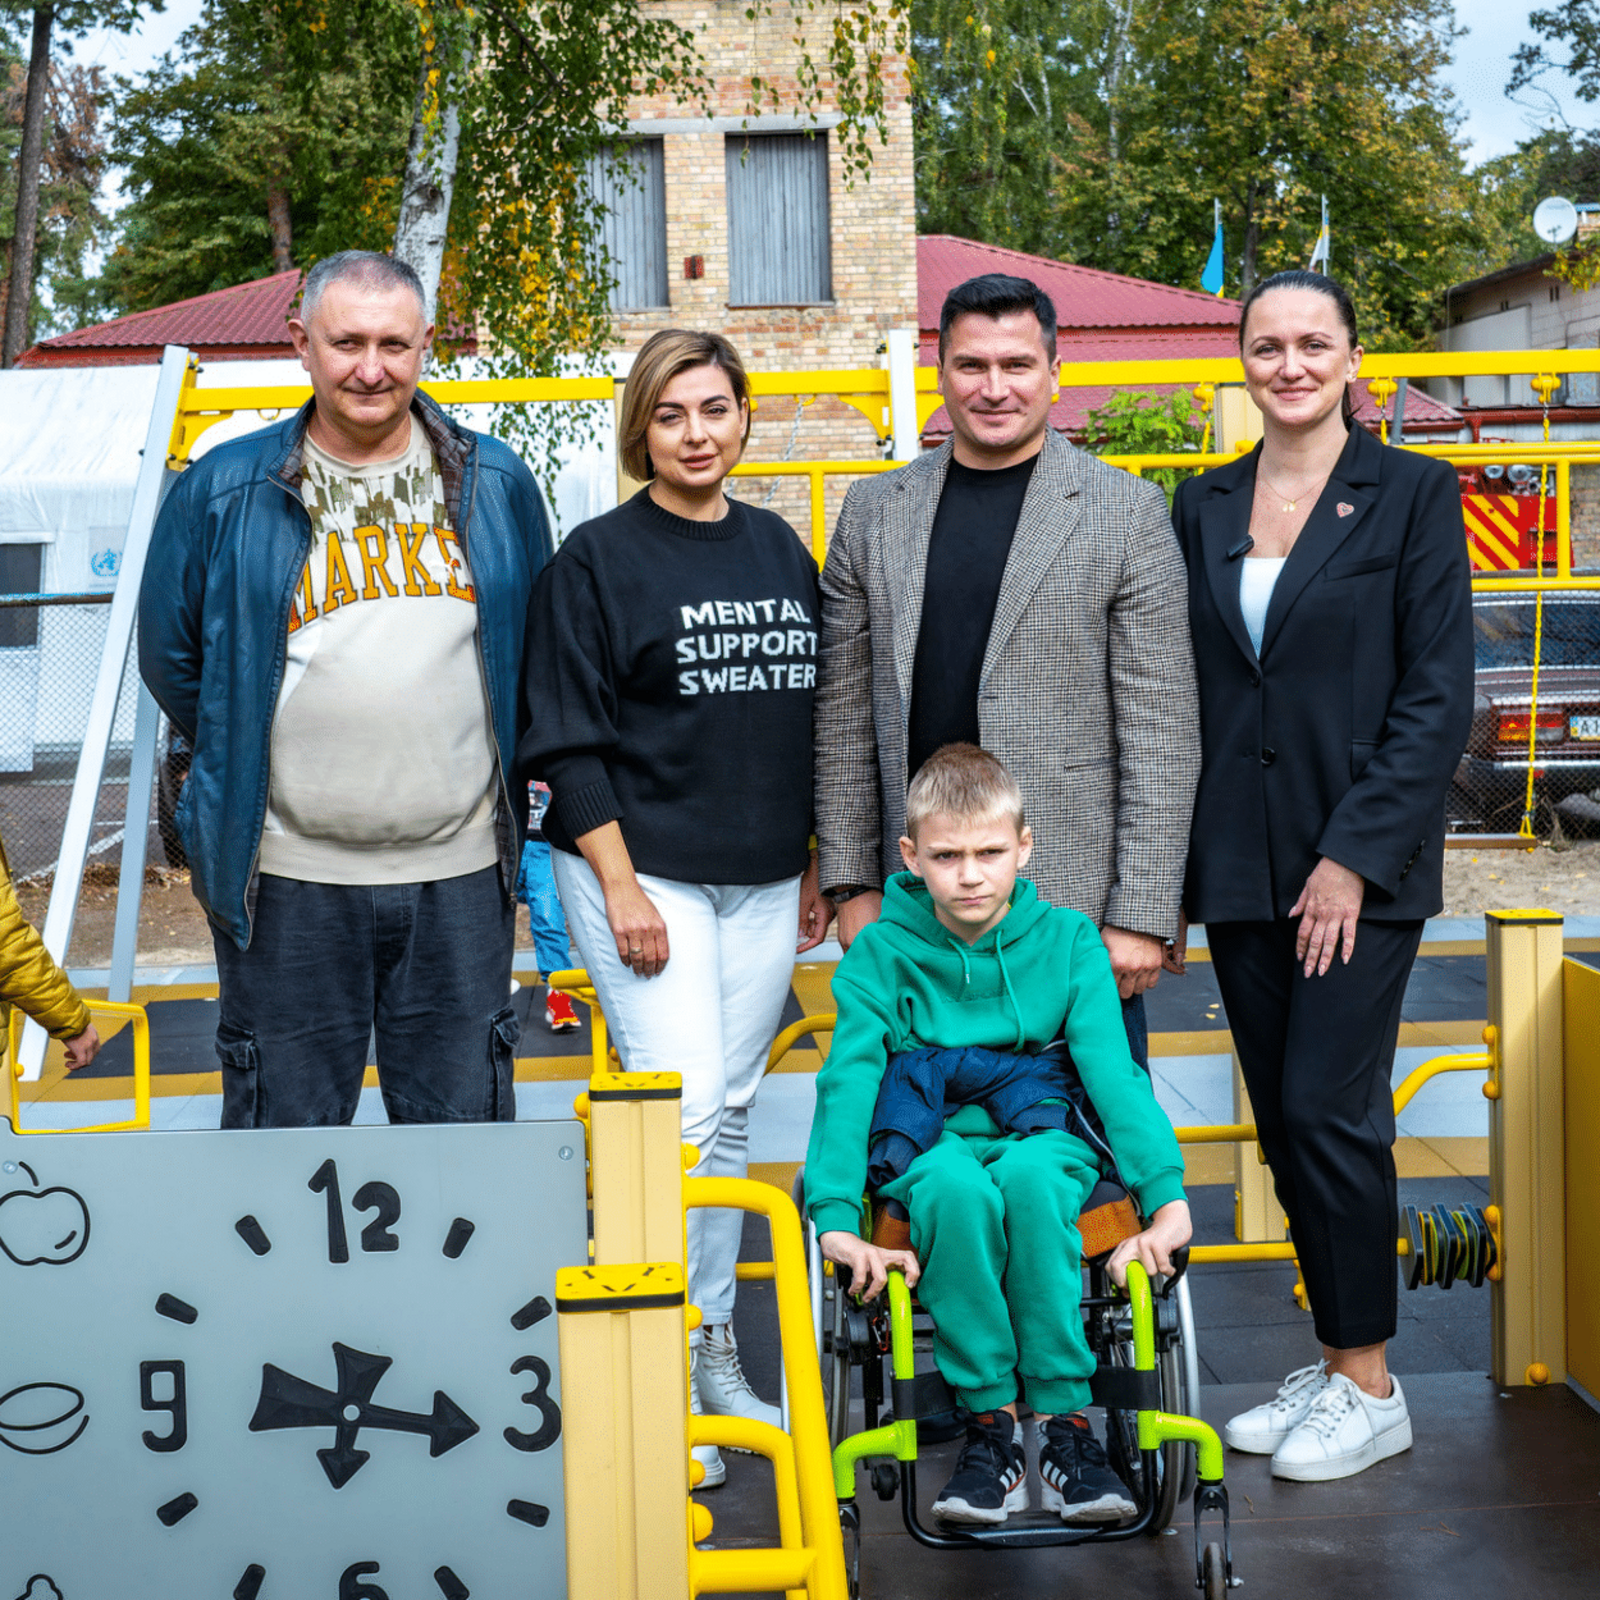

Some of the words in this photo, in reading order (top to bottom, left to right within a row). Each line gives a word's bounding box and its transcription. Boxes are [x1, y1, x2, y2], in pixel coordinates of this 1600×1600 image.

[680, 598, 811, 630] MENTAL
[675, 629, 817, 664] SUPPORT
[678, 663, 816, 695] SWEATER
[307, 1158, 401, 1264] 12
[139, 1360, 187, 1453] 9
[503, 1355, 562, 1452] 3
